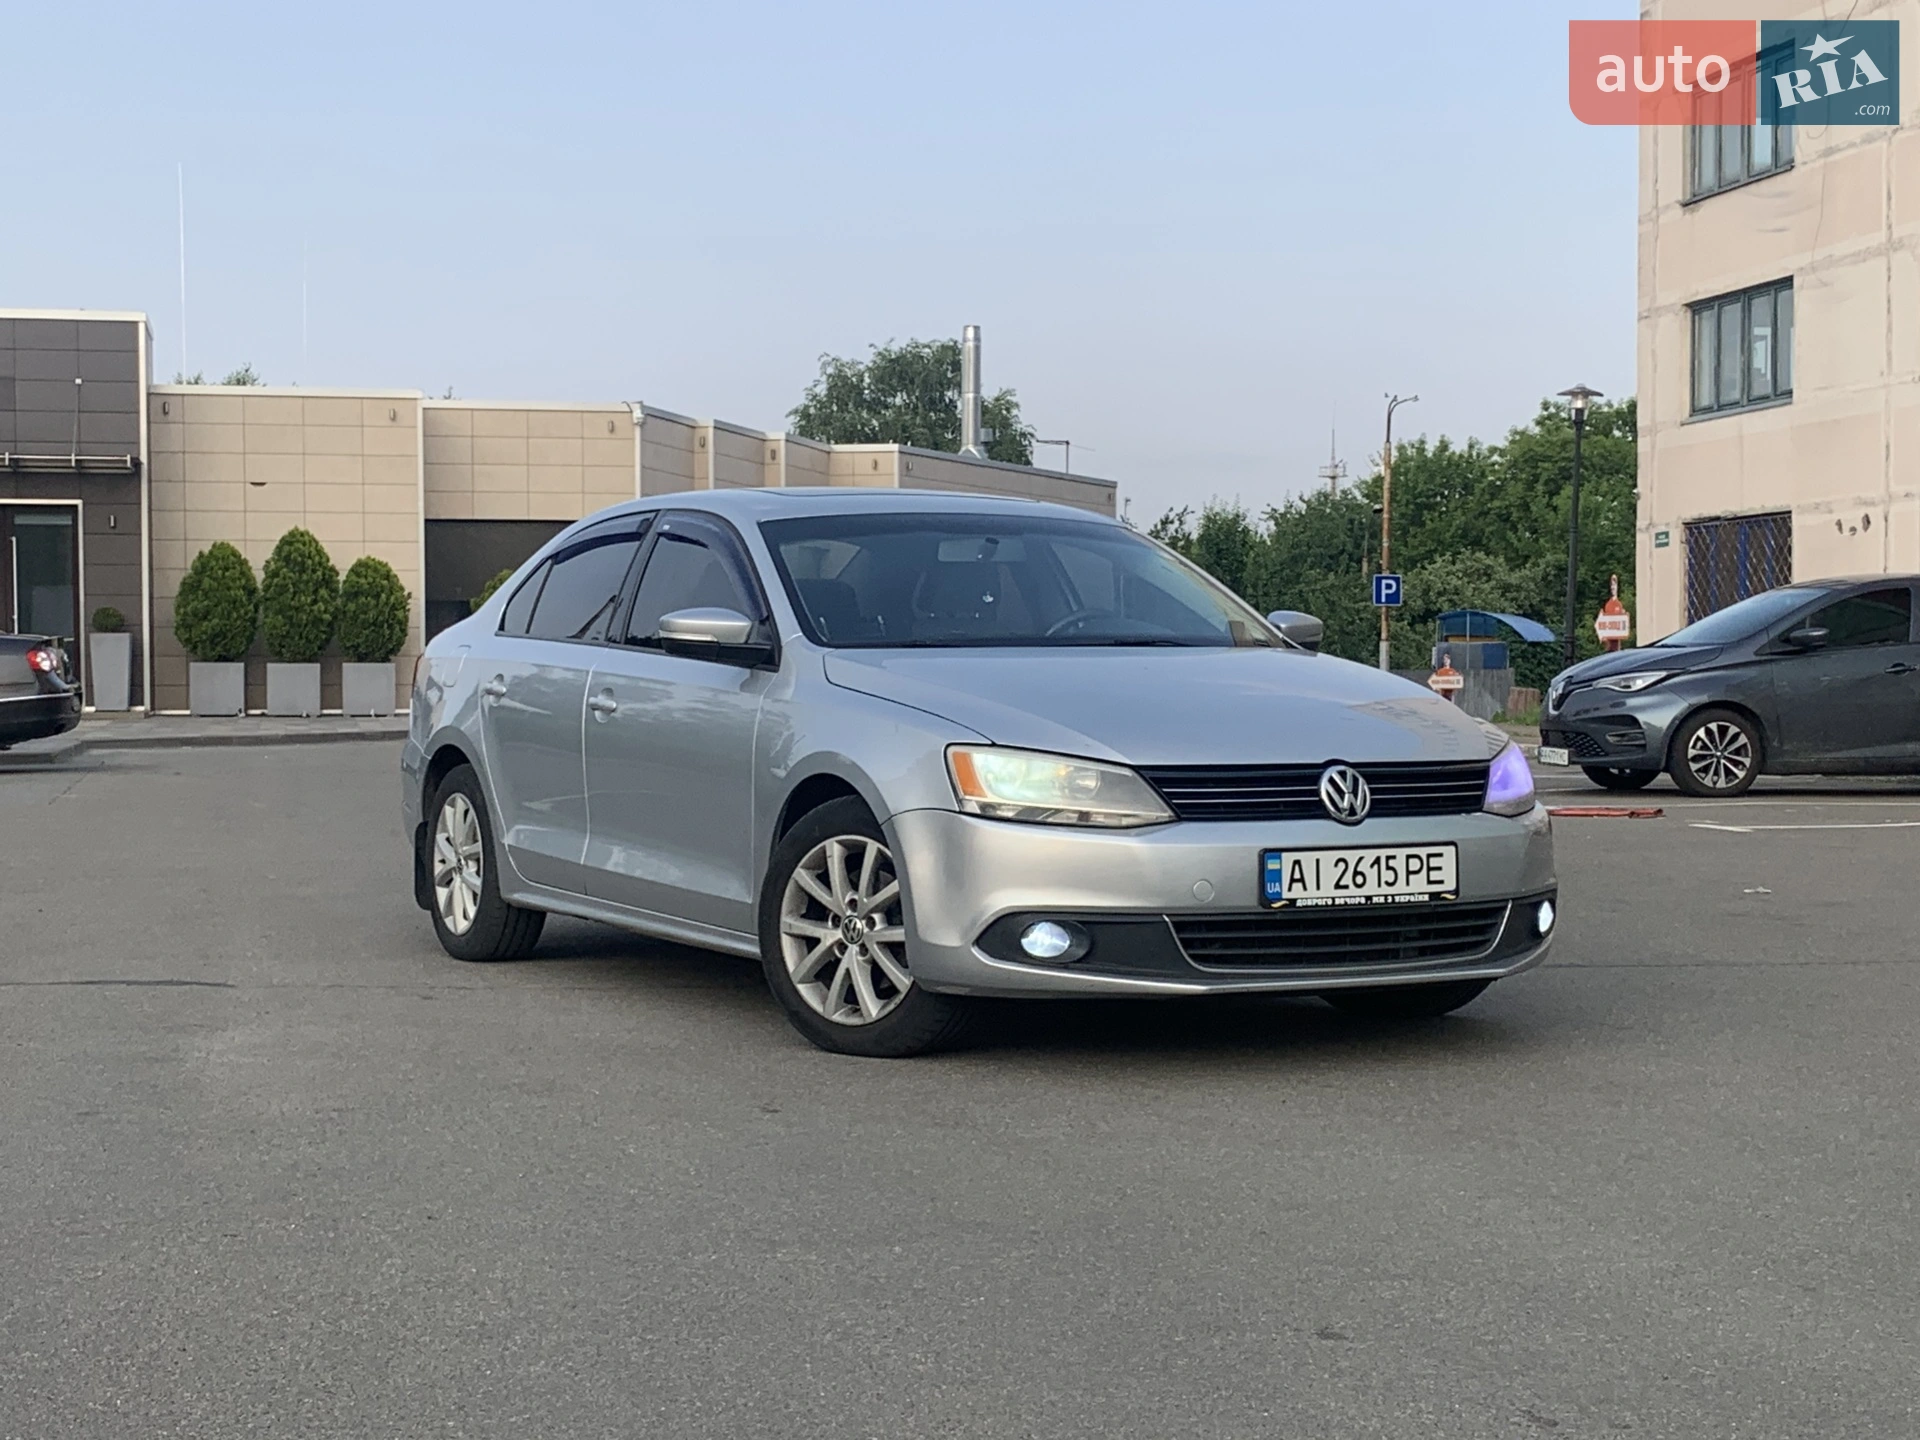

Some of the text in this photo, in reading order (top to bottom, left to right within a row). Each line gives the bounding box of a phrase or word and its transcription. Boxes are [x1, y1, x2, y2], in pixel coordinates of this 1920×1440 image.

[1381, 579, 1397, 602] P
[1287, 857, 1321, 892] AI
[1267, 882, 1281, 894] UA
